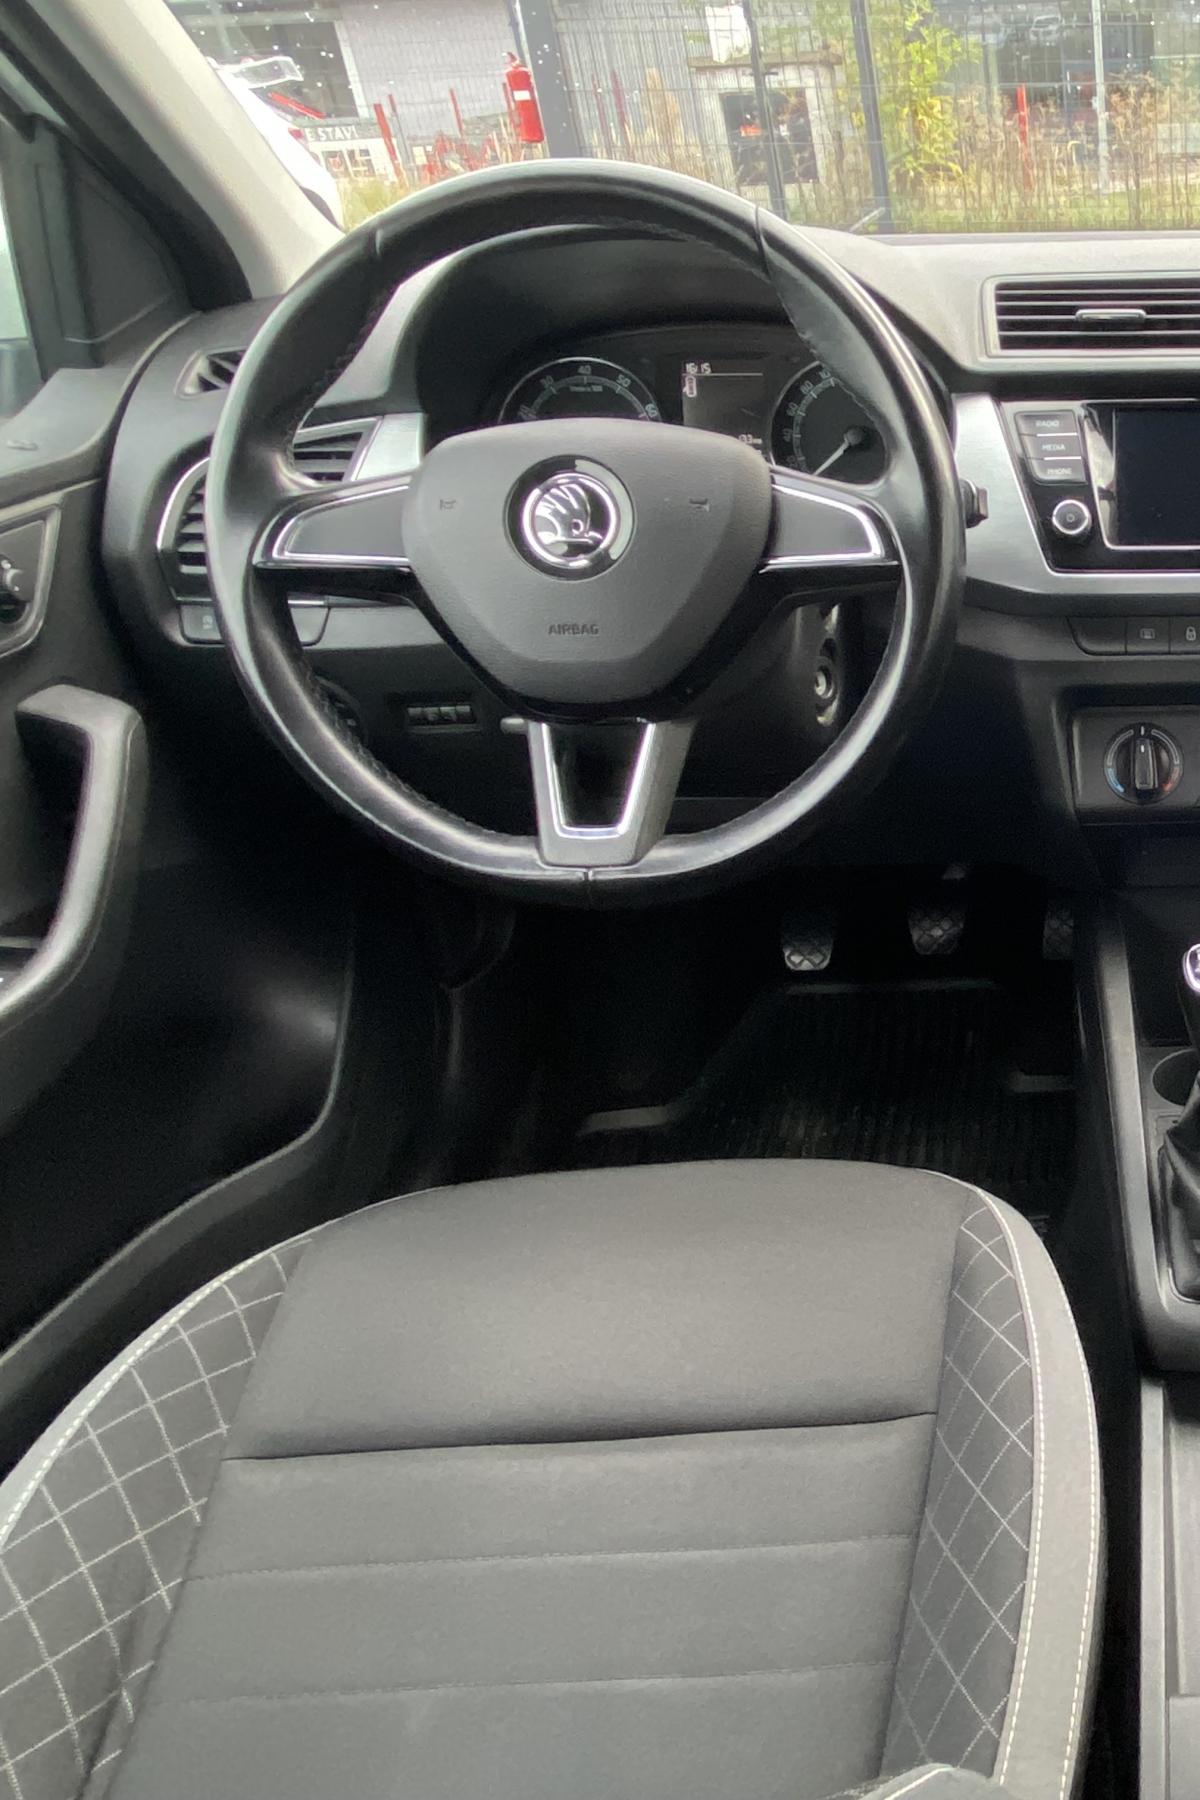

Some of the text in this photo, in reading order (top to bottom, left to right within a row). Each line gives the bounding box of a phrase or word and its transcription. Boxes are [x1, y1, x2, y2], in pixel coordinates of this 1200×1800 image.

[577, 364, 592, 375] 40
[615, 374, 632, 388] 50
[548, 623, 600, 635] AIRBAG
